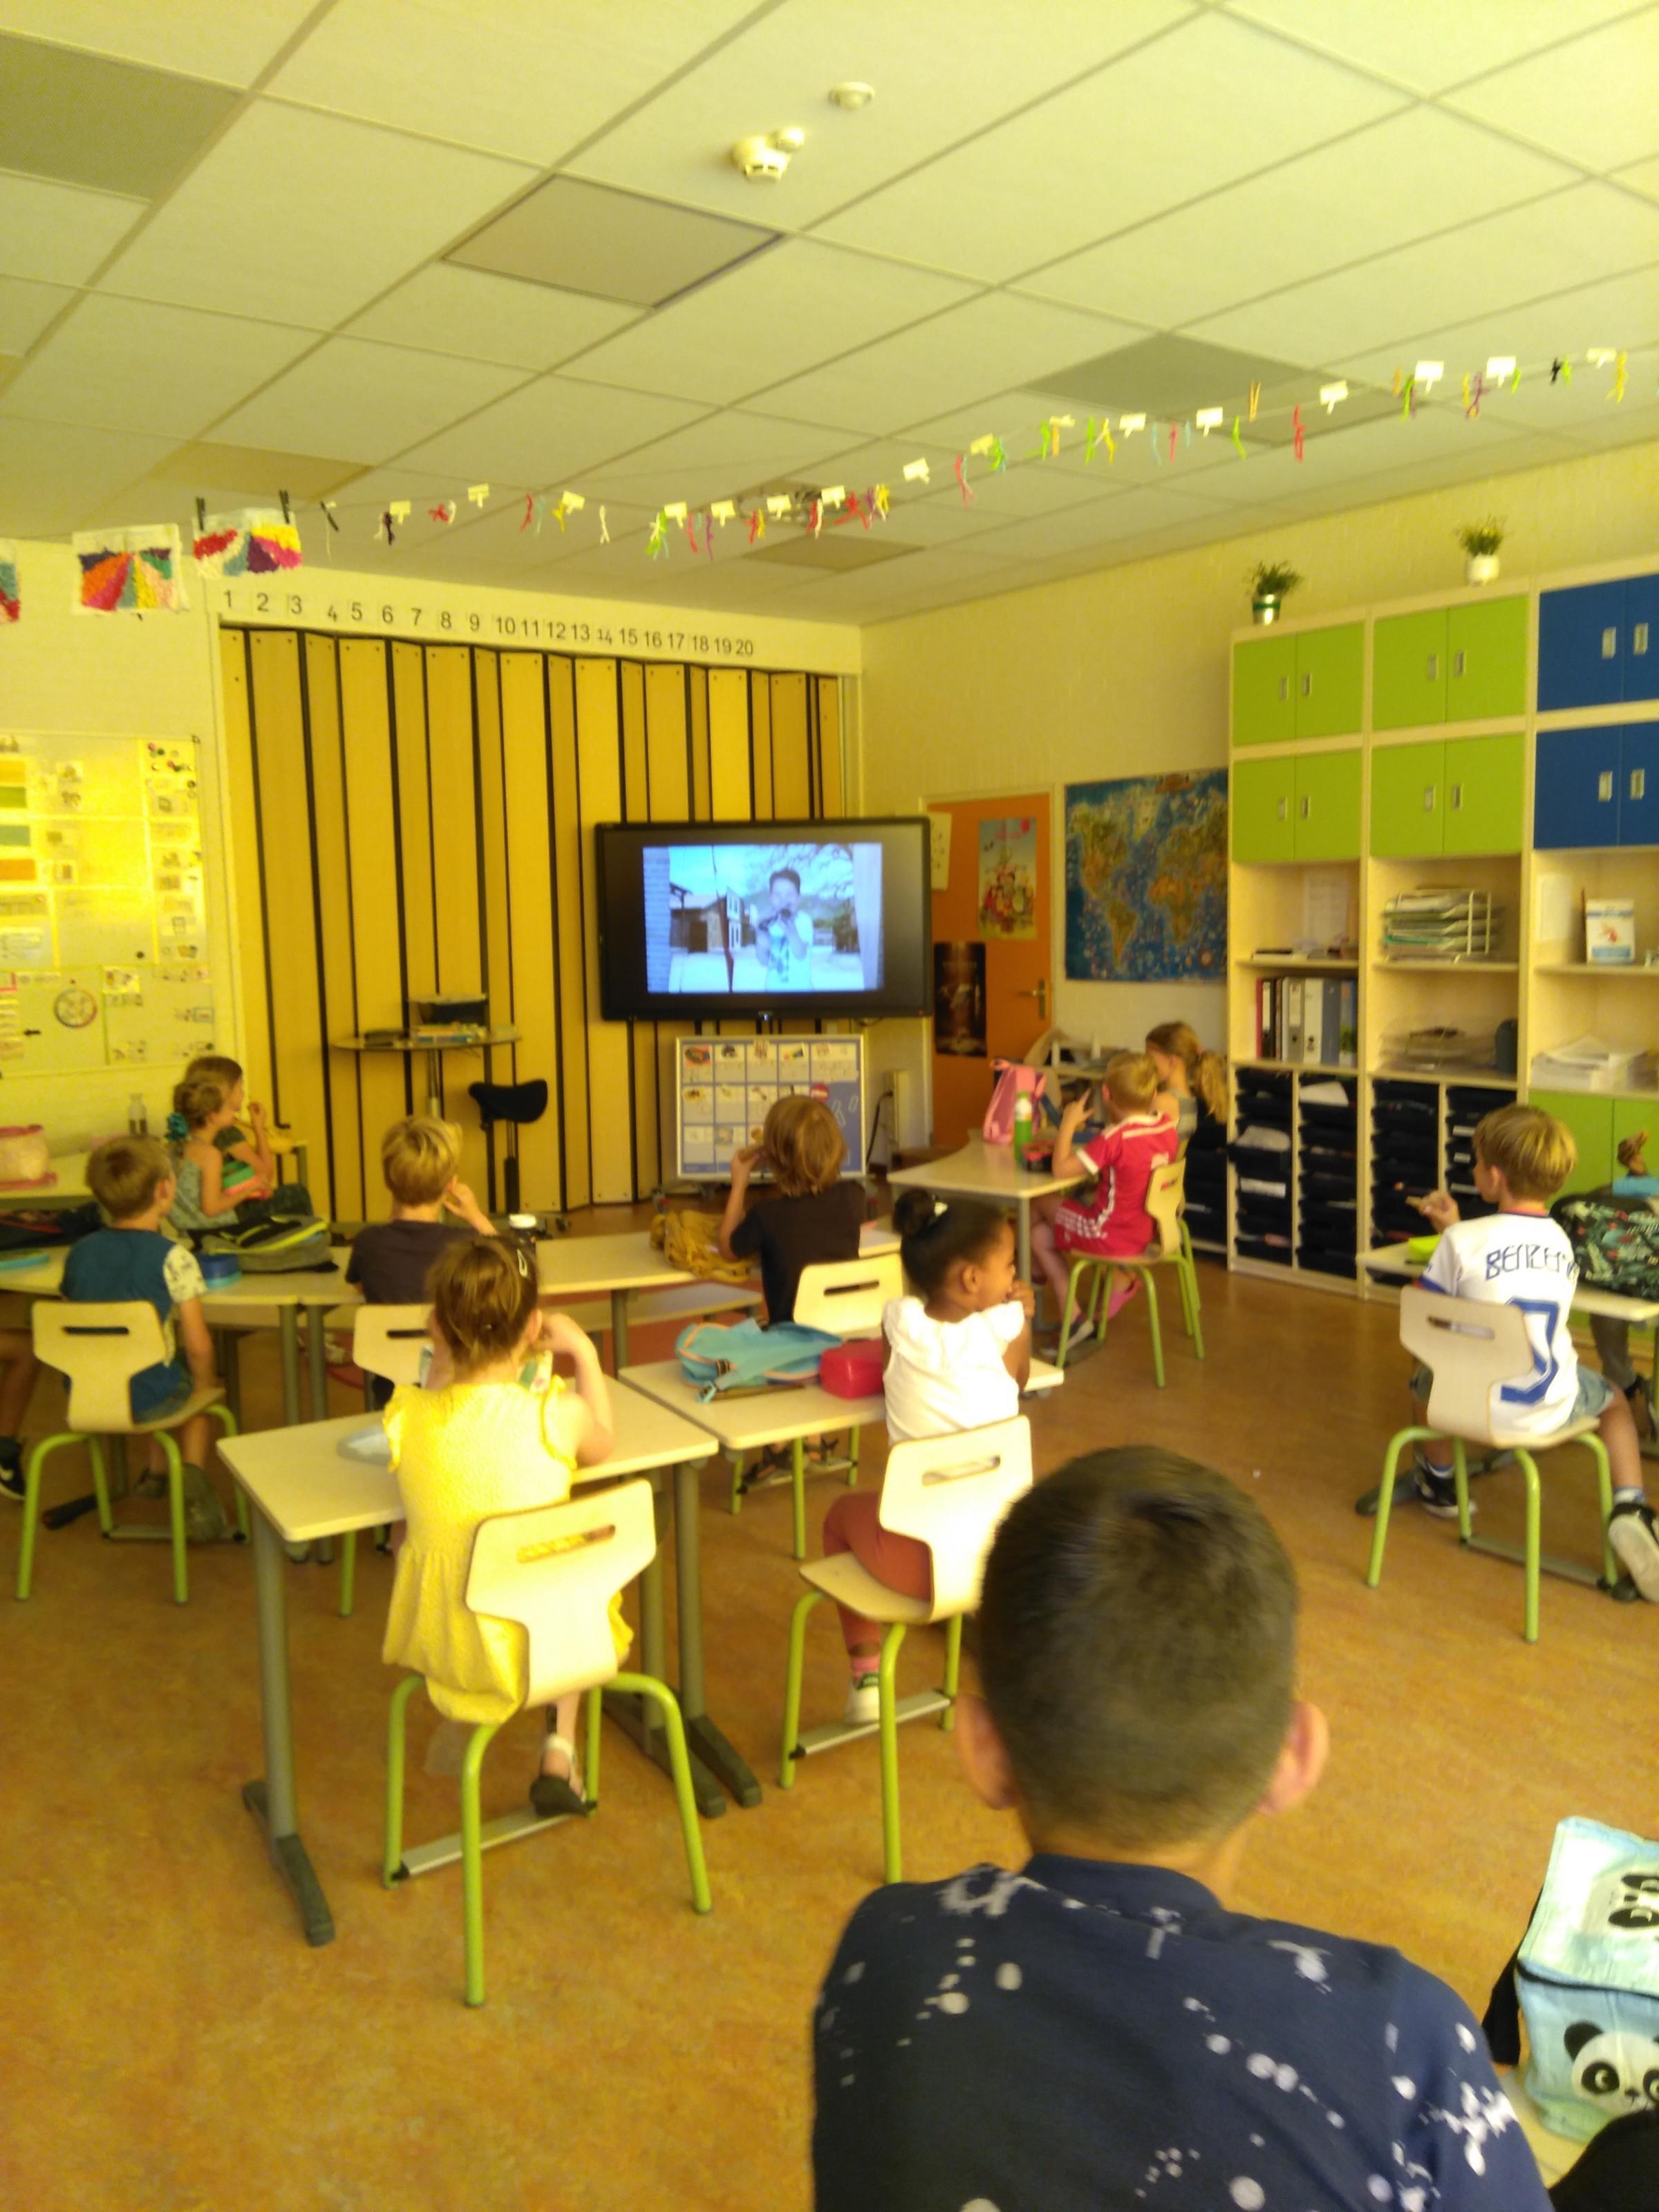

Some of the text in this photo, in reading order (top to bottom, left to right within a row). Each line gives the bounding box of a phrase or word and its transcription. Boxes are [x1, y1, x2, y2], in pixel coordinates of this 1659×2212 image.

[223, 589, 754, 657] 1 2 3 4 5 6 7 8 9 10 11 12 13 14 15 16 17 18 19 20
